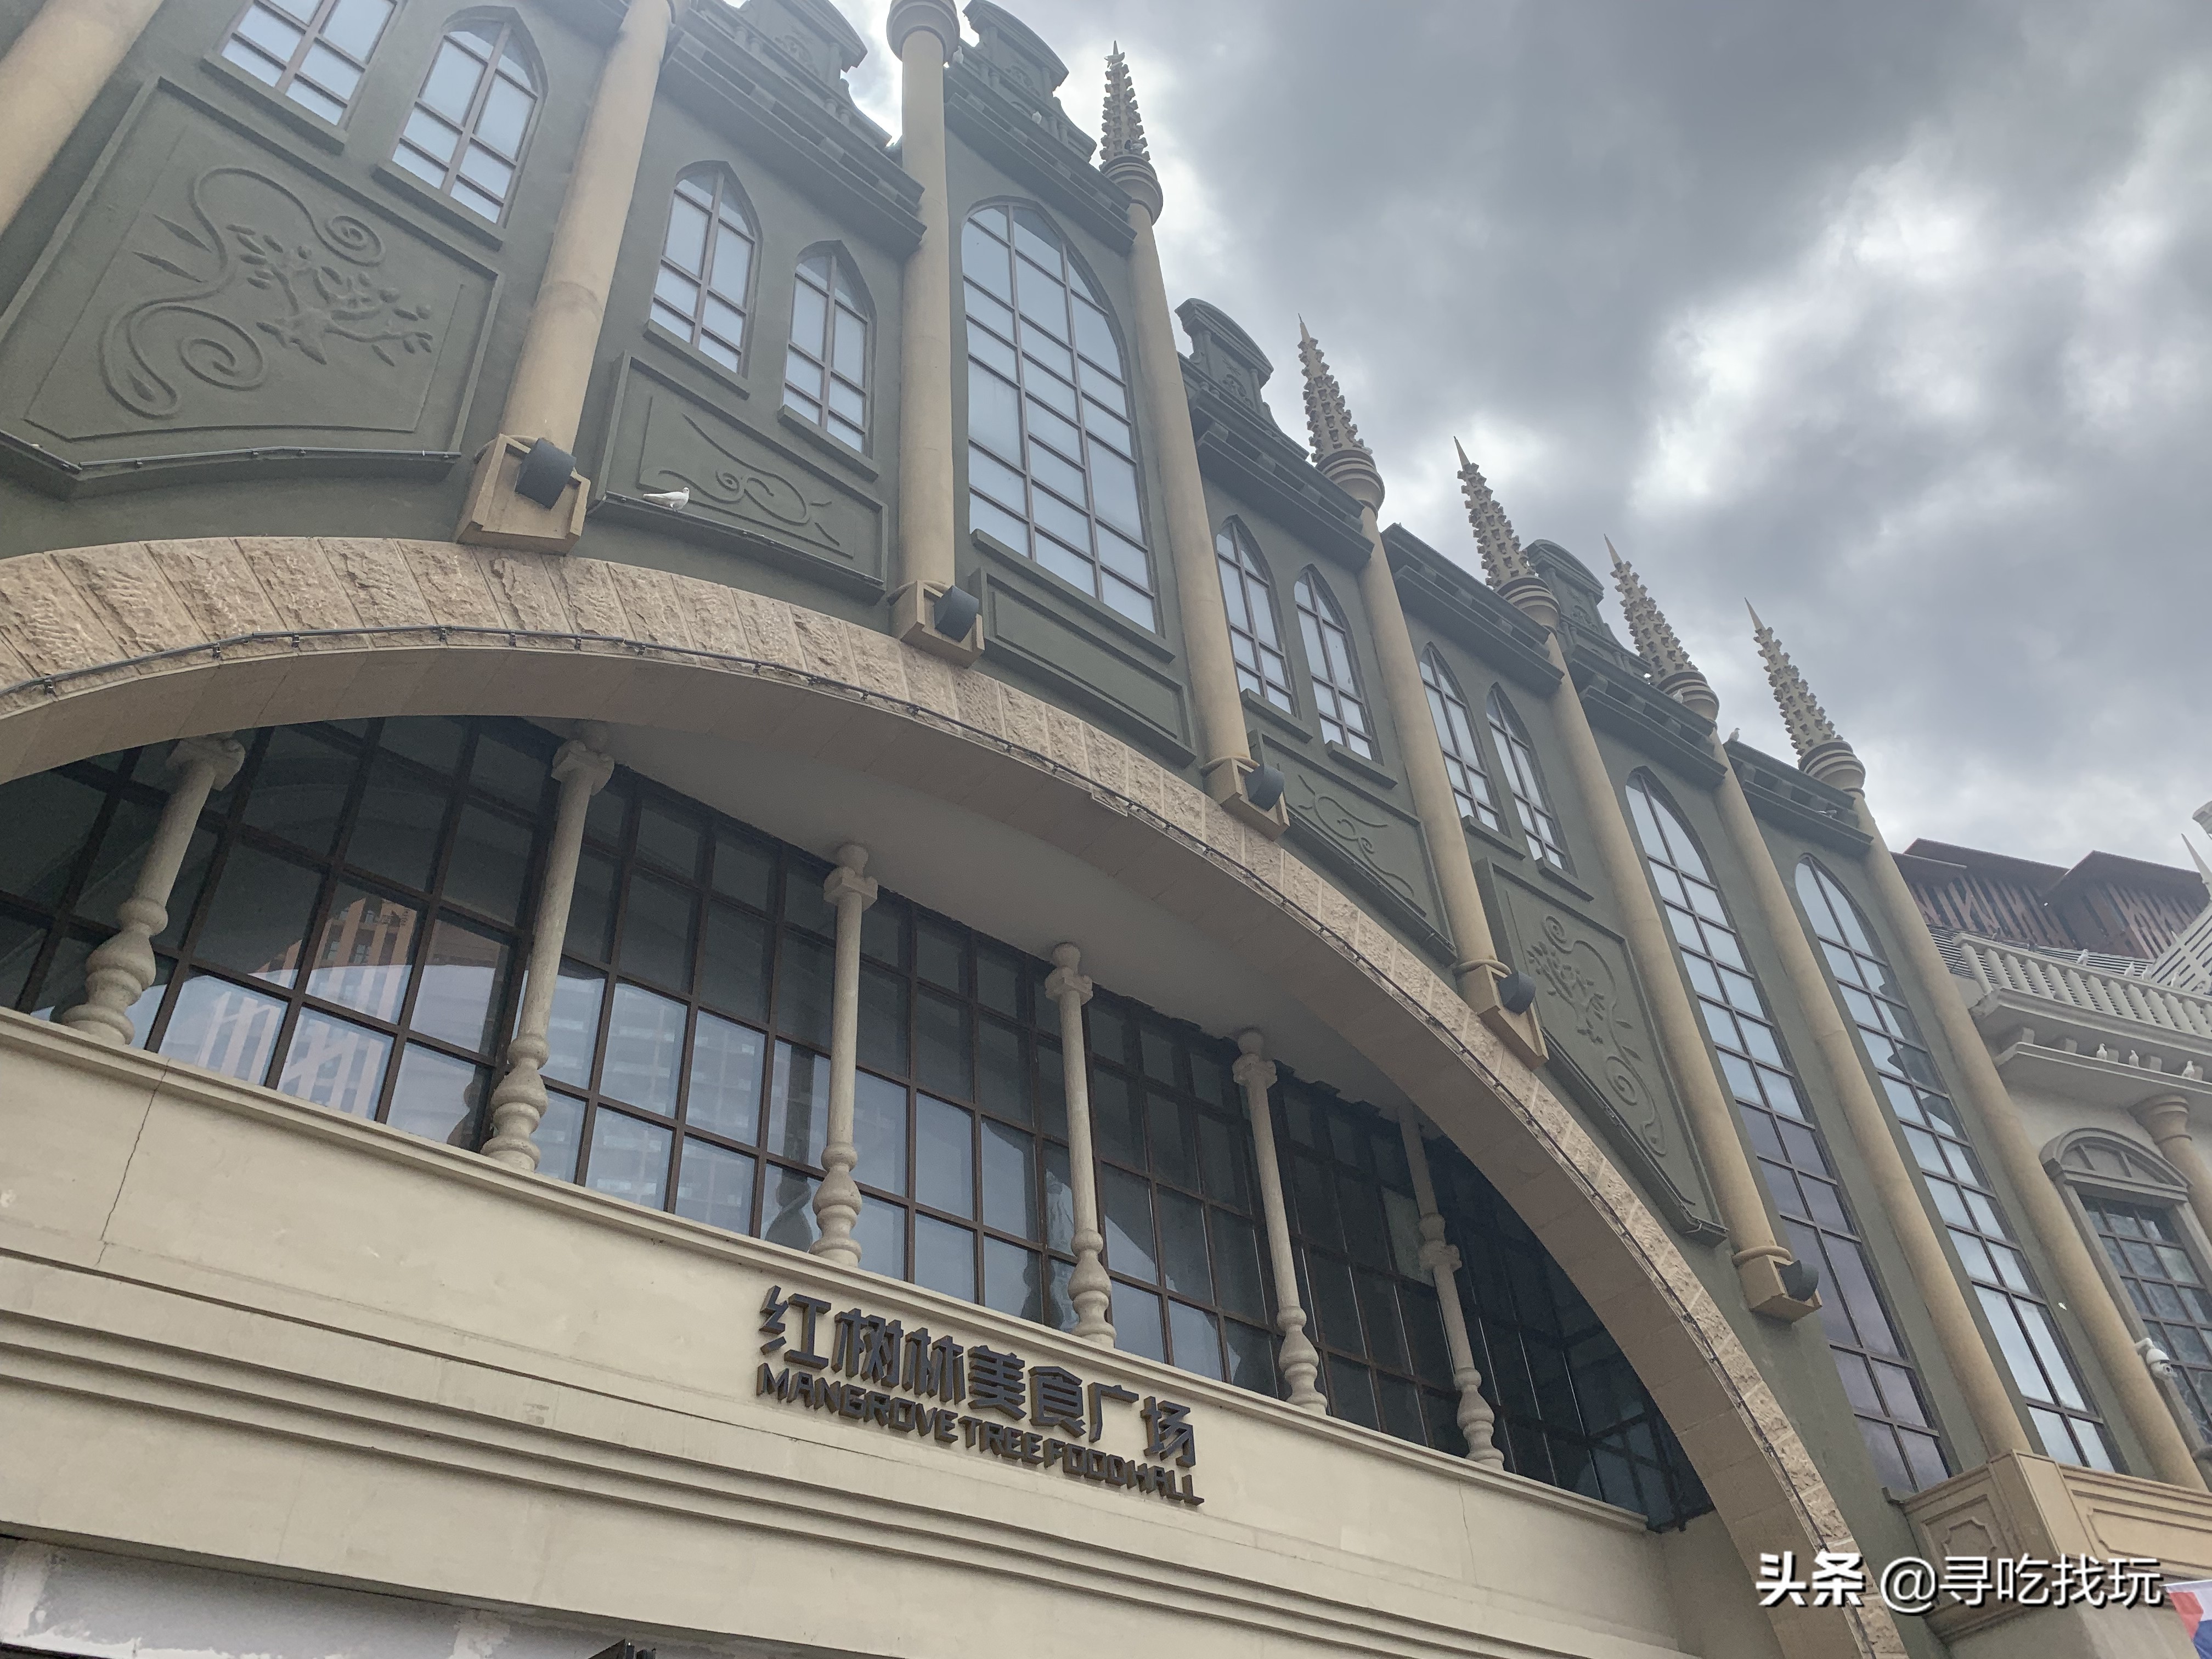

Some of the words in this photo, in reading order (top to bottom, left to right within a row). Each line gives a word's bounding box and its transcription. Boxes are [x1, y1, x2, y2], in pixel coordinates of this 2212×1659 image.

[757, 1363, 959, 1443] MANGROVE
[958, 1415, 1044, 1465] TREE
[759, 1285, 1196, 1468] 红树林美食广场
